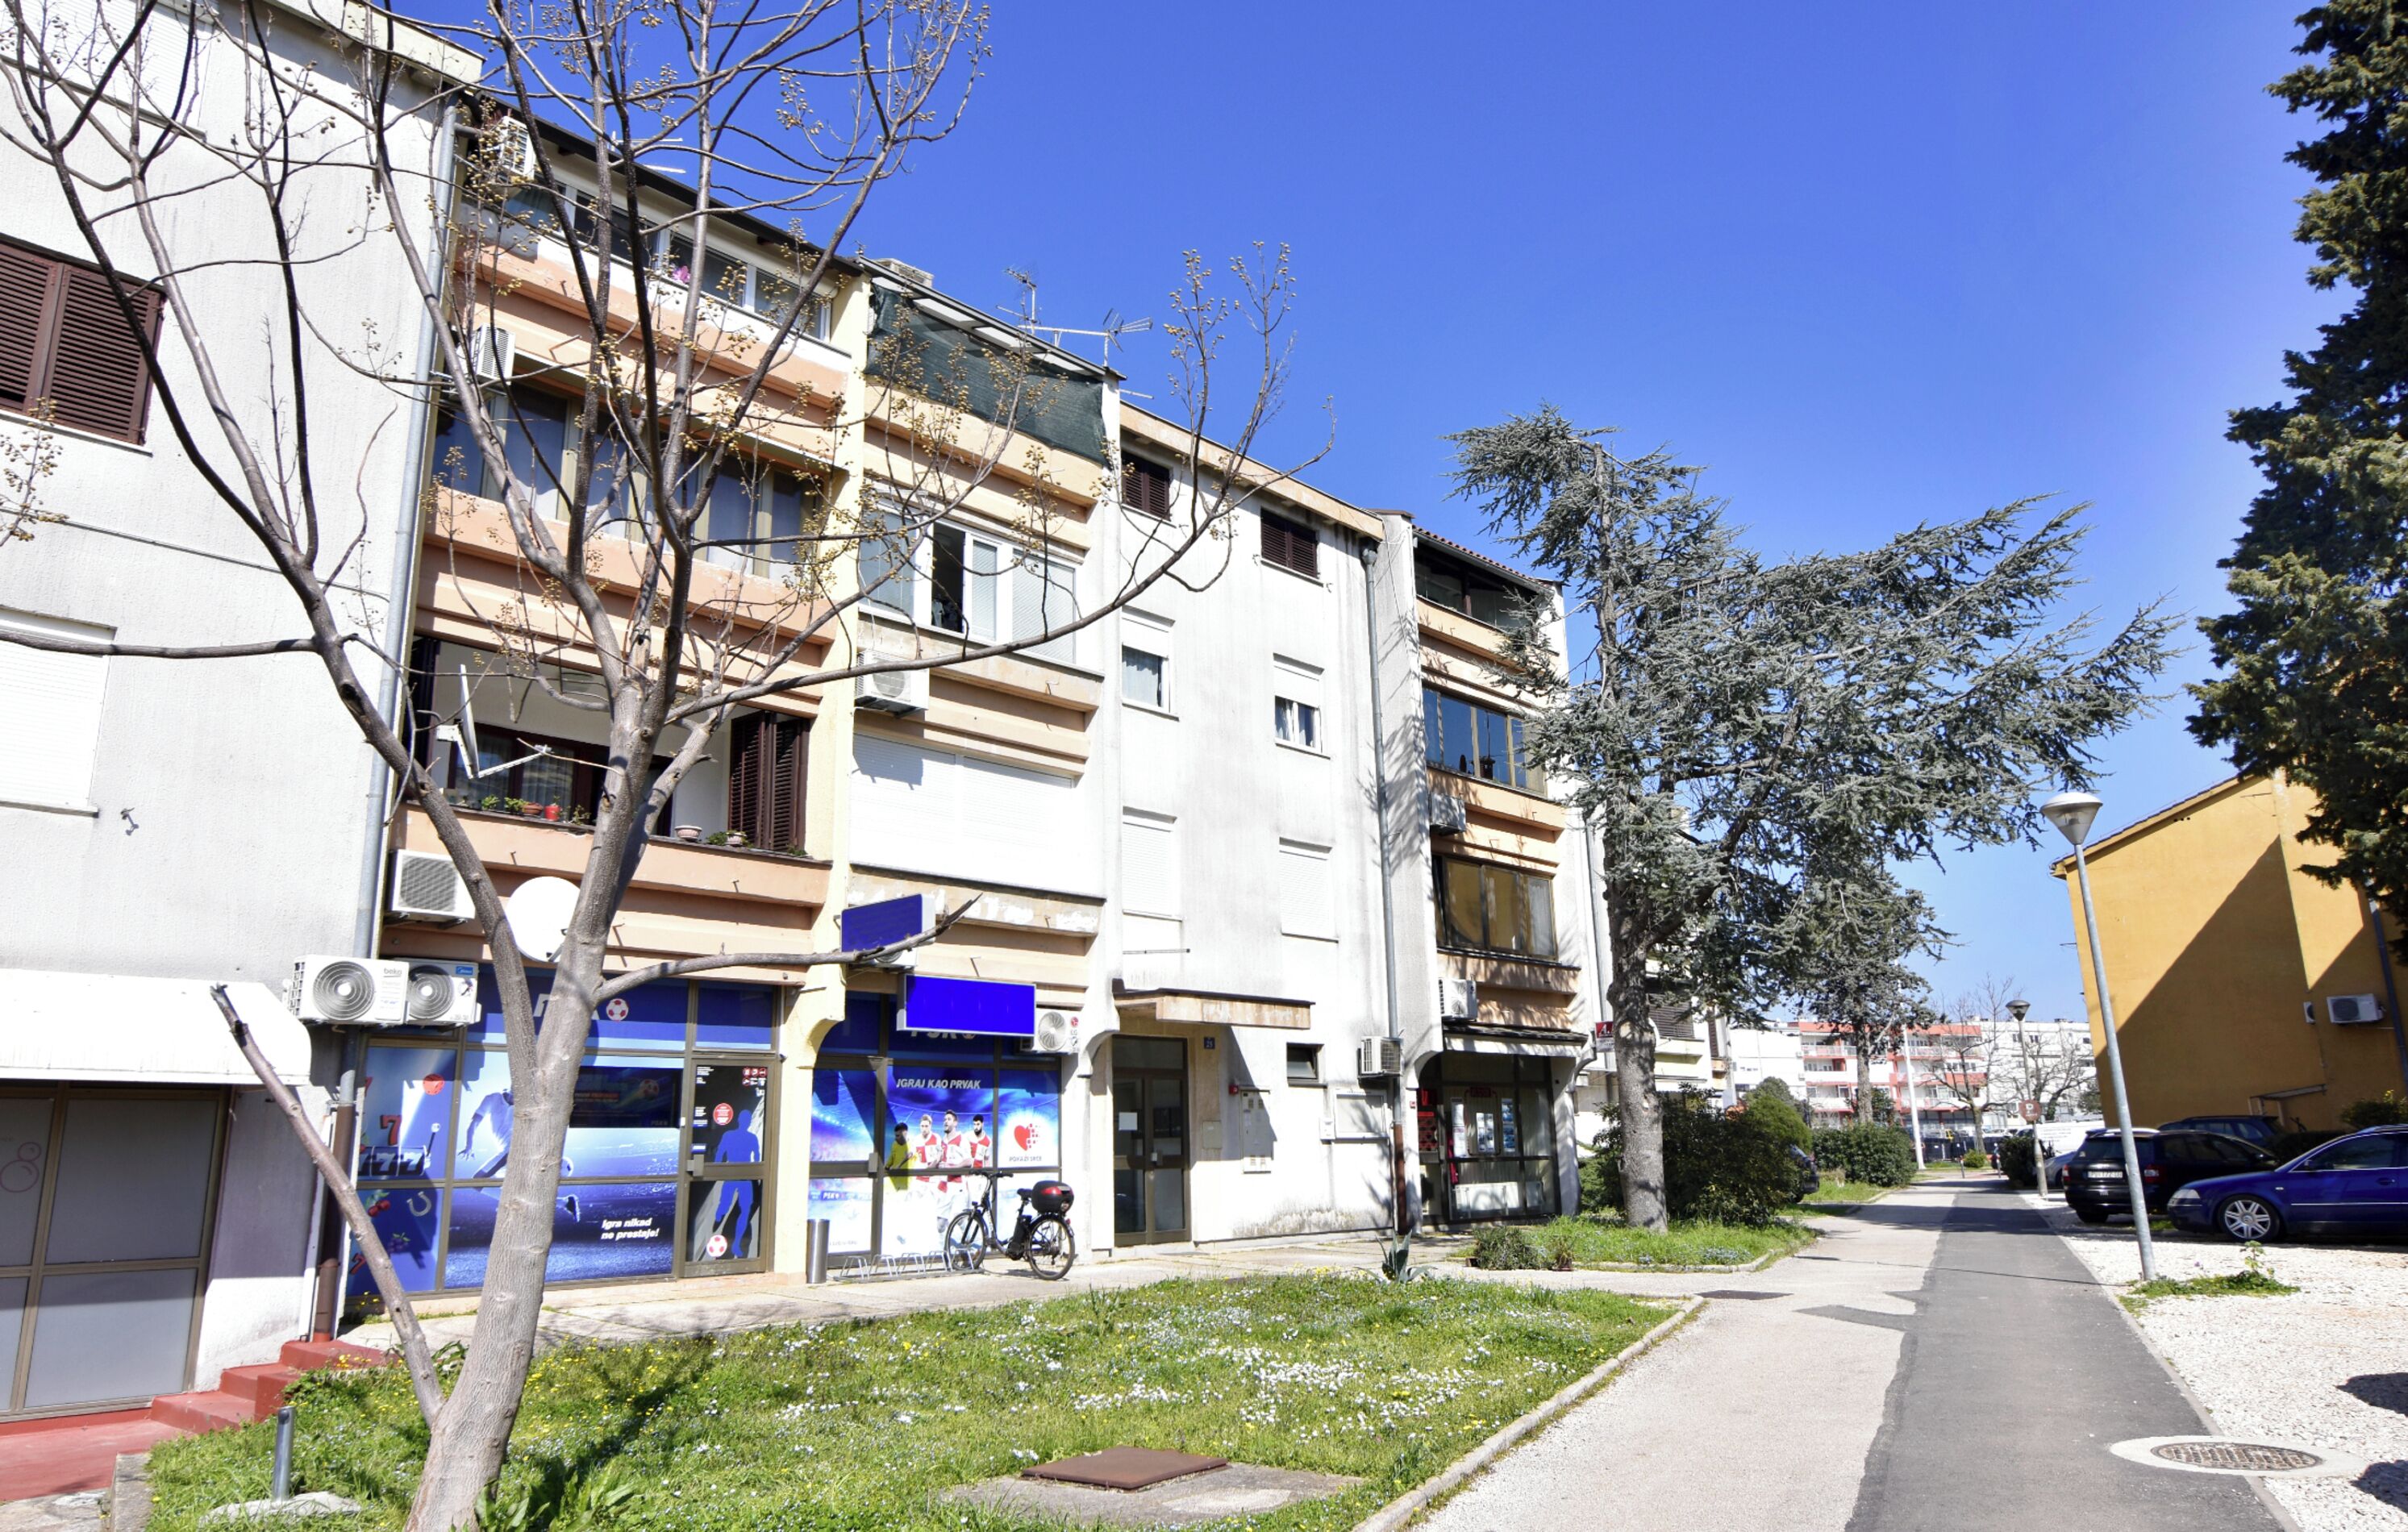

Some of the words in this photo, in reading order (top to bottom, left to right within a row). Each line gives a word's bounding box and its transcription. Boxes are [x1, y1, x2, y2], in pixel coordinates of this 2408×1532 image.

[896, 1078, 925, 1089] IGRAJ
[927, 1079, 949, 1089] KAO
[949, 1080, 981, 1089] PRVAK
[602, 1218, 623, 1230] Igra
[623, 1217, 652, 1227] nikad
[601, 1232, 614, 1240] ne
[615, 1227, 660, 1242] prestaje!
